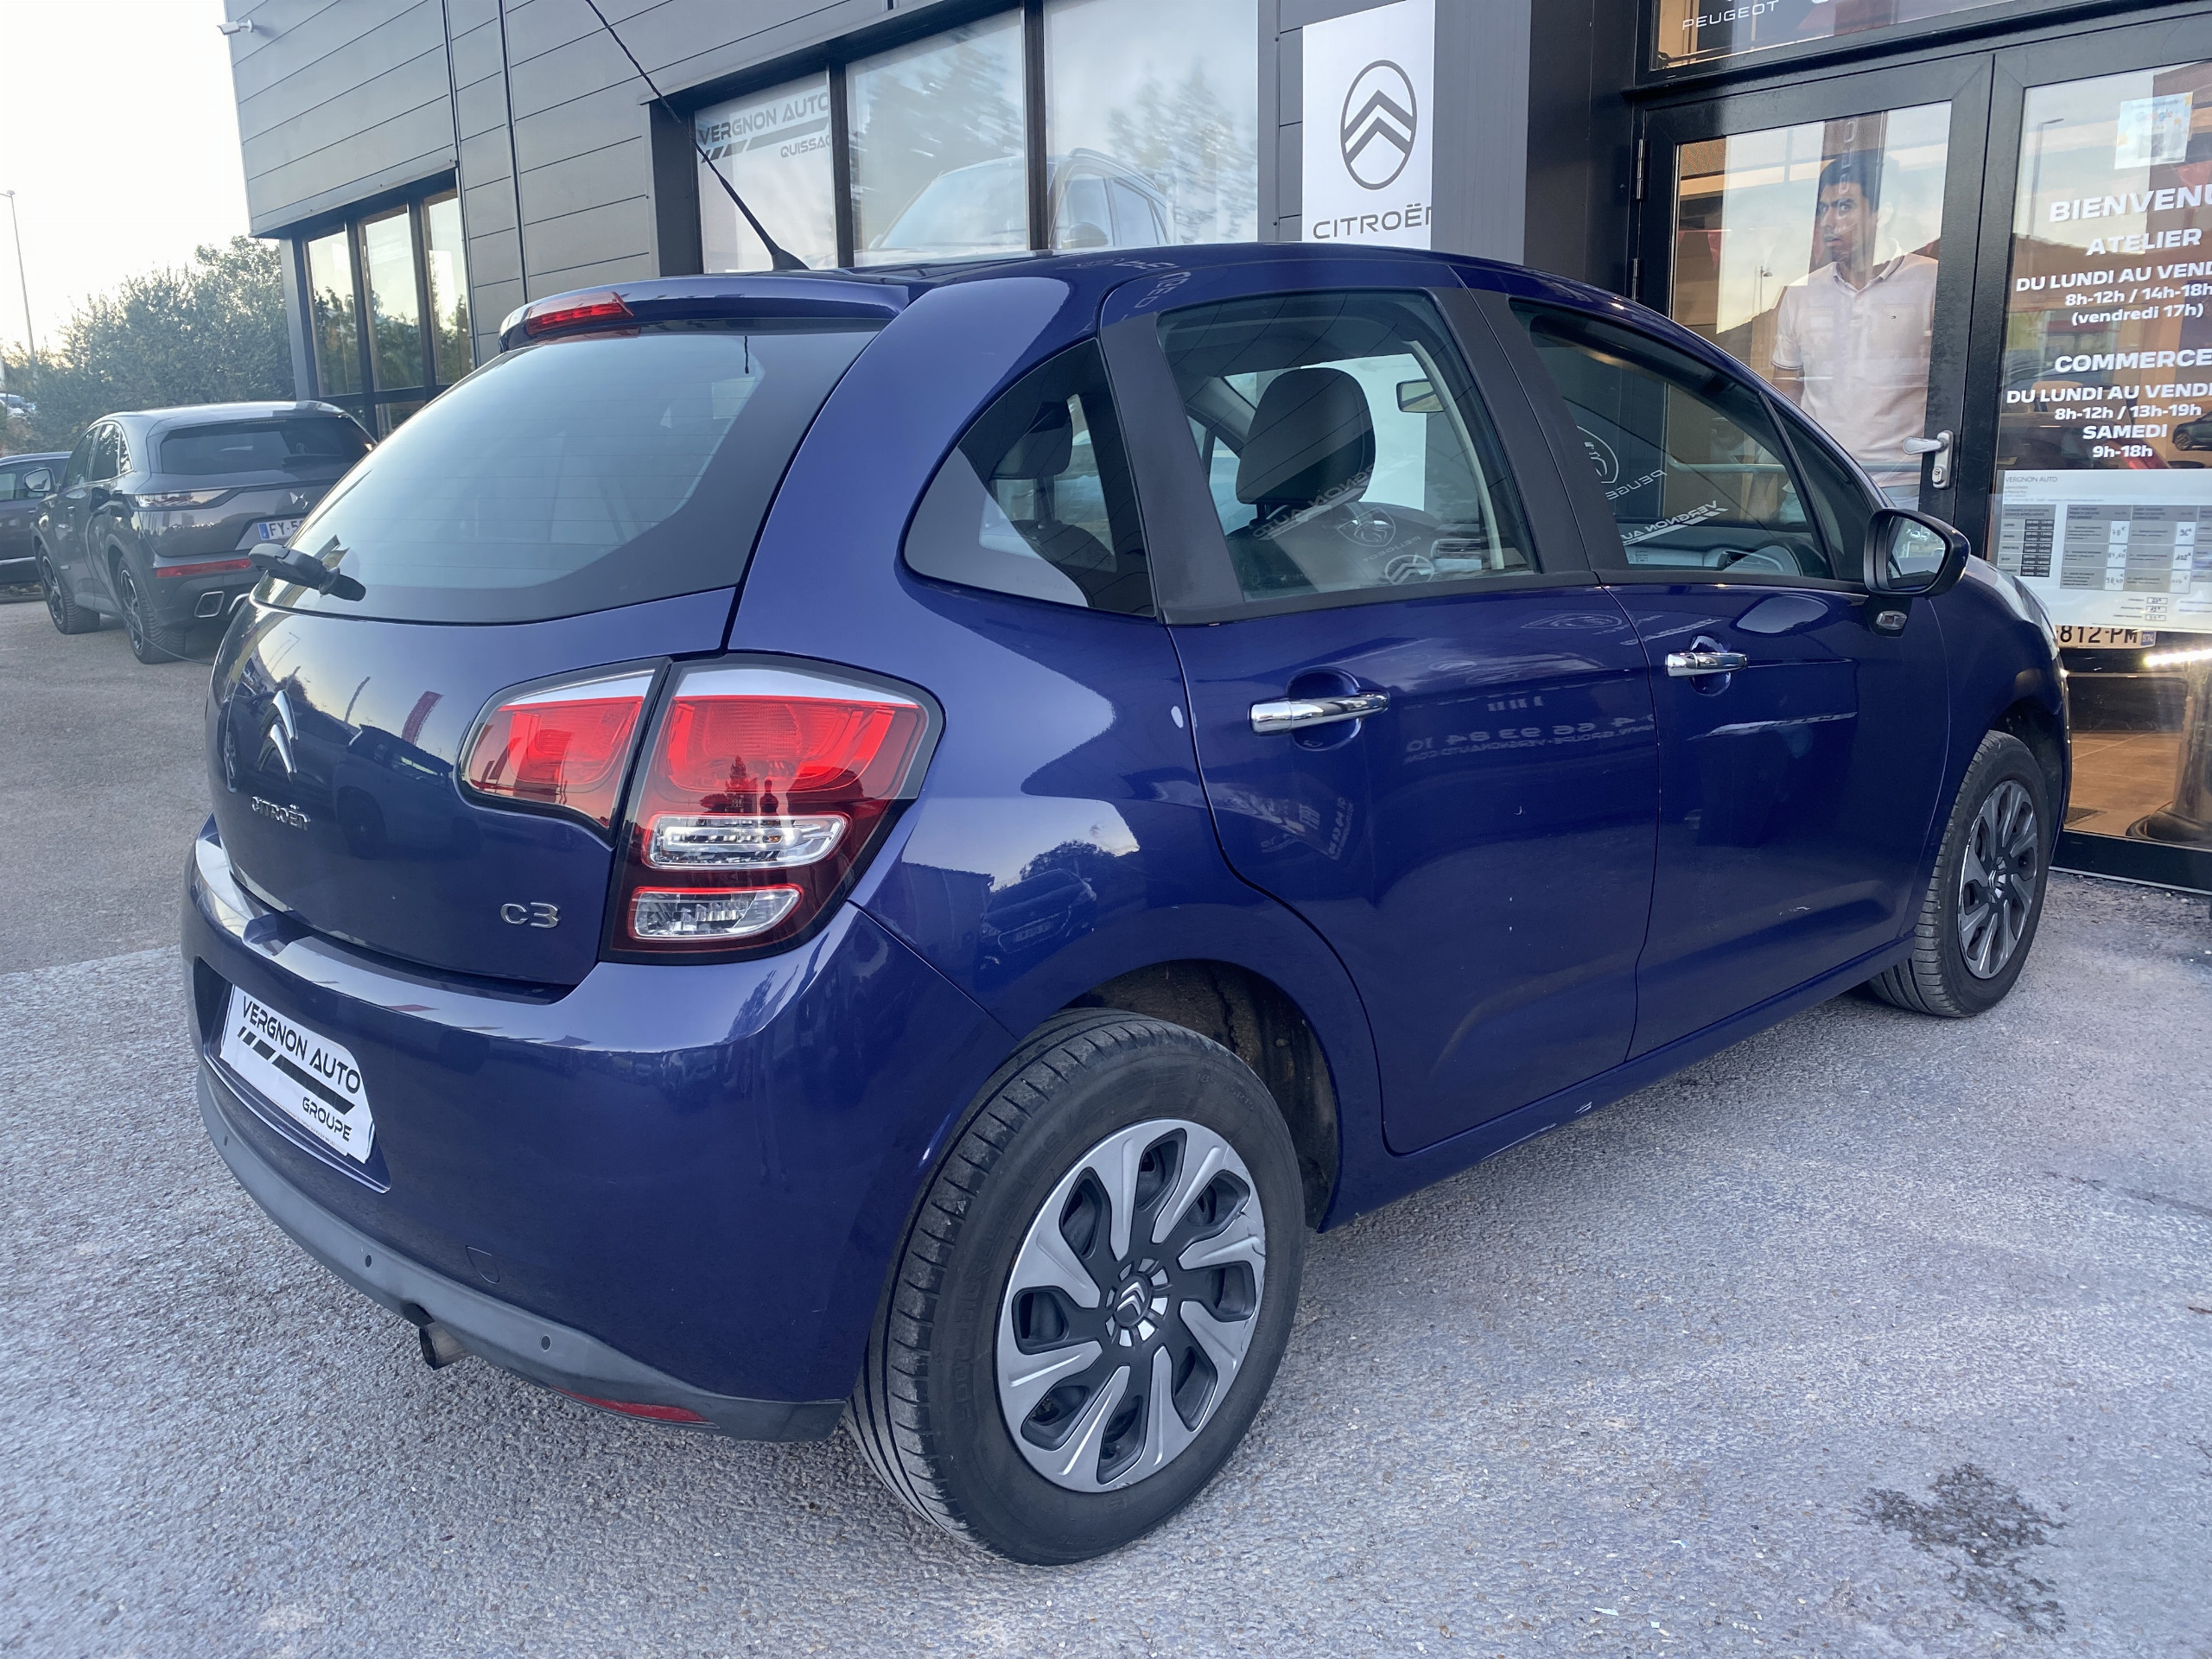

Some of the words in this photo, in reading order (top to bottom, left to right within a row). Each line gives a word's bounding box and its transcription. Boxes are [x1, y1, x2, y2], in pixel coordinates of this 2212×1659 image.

[1681, 2, 1776, 30] PEUGEOT
[698, 108, 777, 145] VERGNON
[782, 92, 830, 123] AUTO
[2086, 228, 2202, 256] ATELIER
[2016, 276, 2046, 292] DU
[2050, 270, 2113, 289] LUNDI
[2119, 266, 2152, 283] AU
[2065, 289, 2125, 307] 8h-12h
[2142, 283, 2212, 302] 14h-18h
[2071, 306, 2158, 327] (vendredi
[2164, 303, 2204, 320] 17h)
[2055, 348, 2212, 373] COMMERCE
[2006, 390, 2036, 404] DU
[2040, 387, 2103, 403] LUNDI
[2108, 385, 2139, 400] AU
[2145, 383, 2212, 398] VEND
[2055, 407, 2114, 421] 8h-12h
[2130, 404, 2202, 418] 13h-19h
[2082, 423, 2168, 440] SAMEDI
[2093, 445, 2153, 458] 9h-18h
[251, 796, 312, 830] CITROËN
[499, 901, 562, 929] C3
[243, 995, 308, 1061] VERGNON
[309, 1047, 361, 1094] AUTO
[302, 1096, 353, 1142] GROUPE
